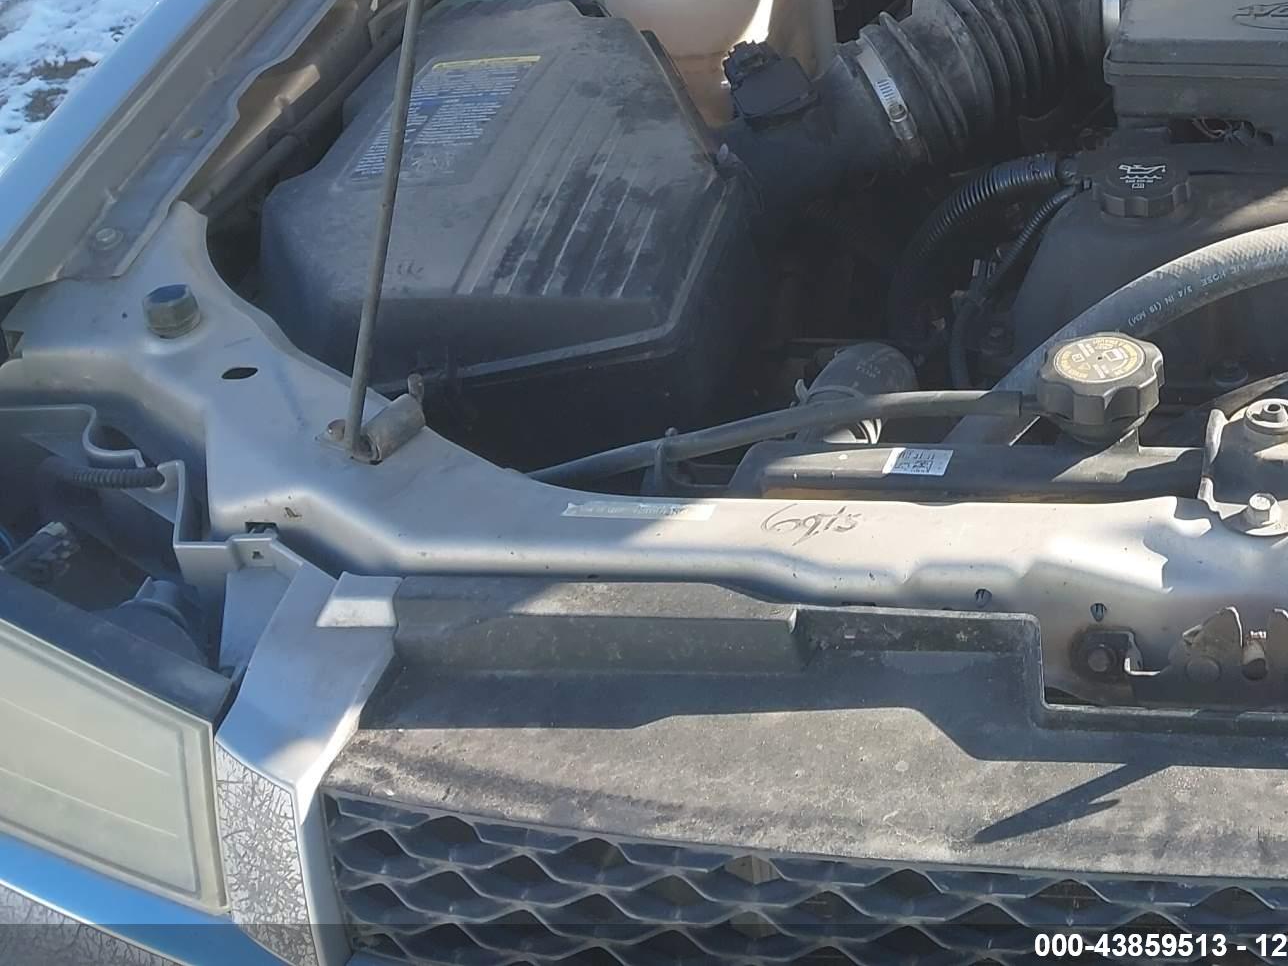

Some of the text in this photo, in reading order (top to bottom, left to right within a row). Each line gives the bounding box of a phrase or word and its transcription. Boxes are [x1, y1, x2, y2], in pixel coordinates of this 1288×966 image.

[1200, 270, 1227, 286] HOSE
[1177, 286, 1192, 298] 3/4
[1164, 294, 1175, 305] IN
